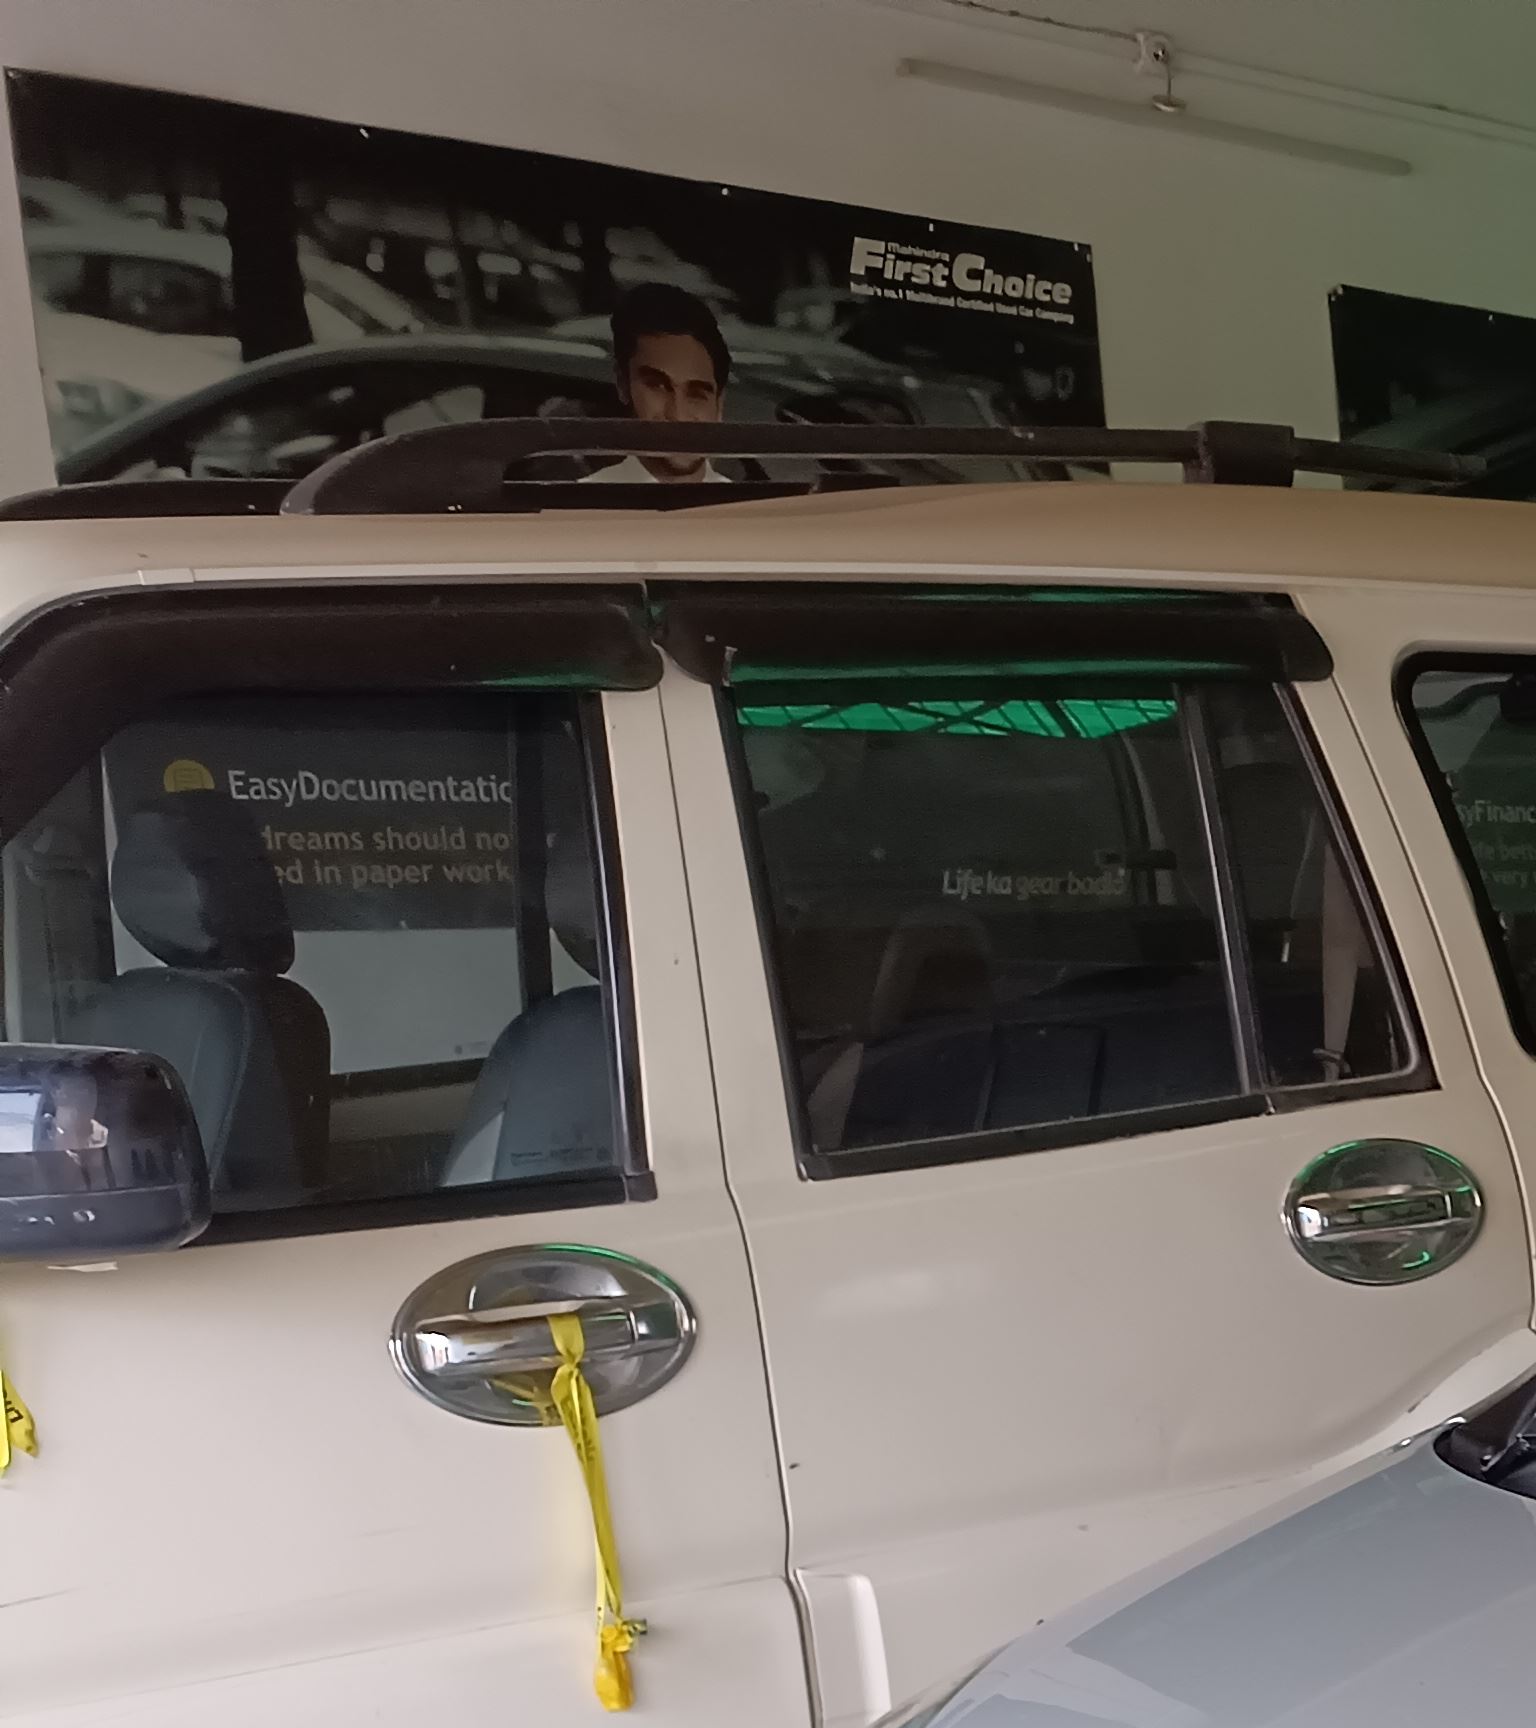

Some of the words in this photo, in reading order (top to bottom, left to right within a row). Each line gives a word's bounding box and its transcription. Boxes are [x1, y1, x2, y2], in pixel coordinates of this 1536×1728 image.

[850, 237, 949, 287] First
[952, 253, 1072, 304] Choice
[227, 769, 512, 808] EasyDocumentatio
[371, 826, 465, 851] should
[474, 832, 513, 850] no
[314, 860, 342, 885] in
[351, 862, 433, 890] paper
[942, 868, 983, 901] Life
